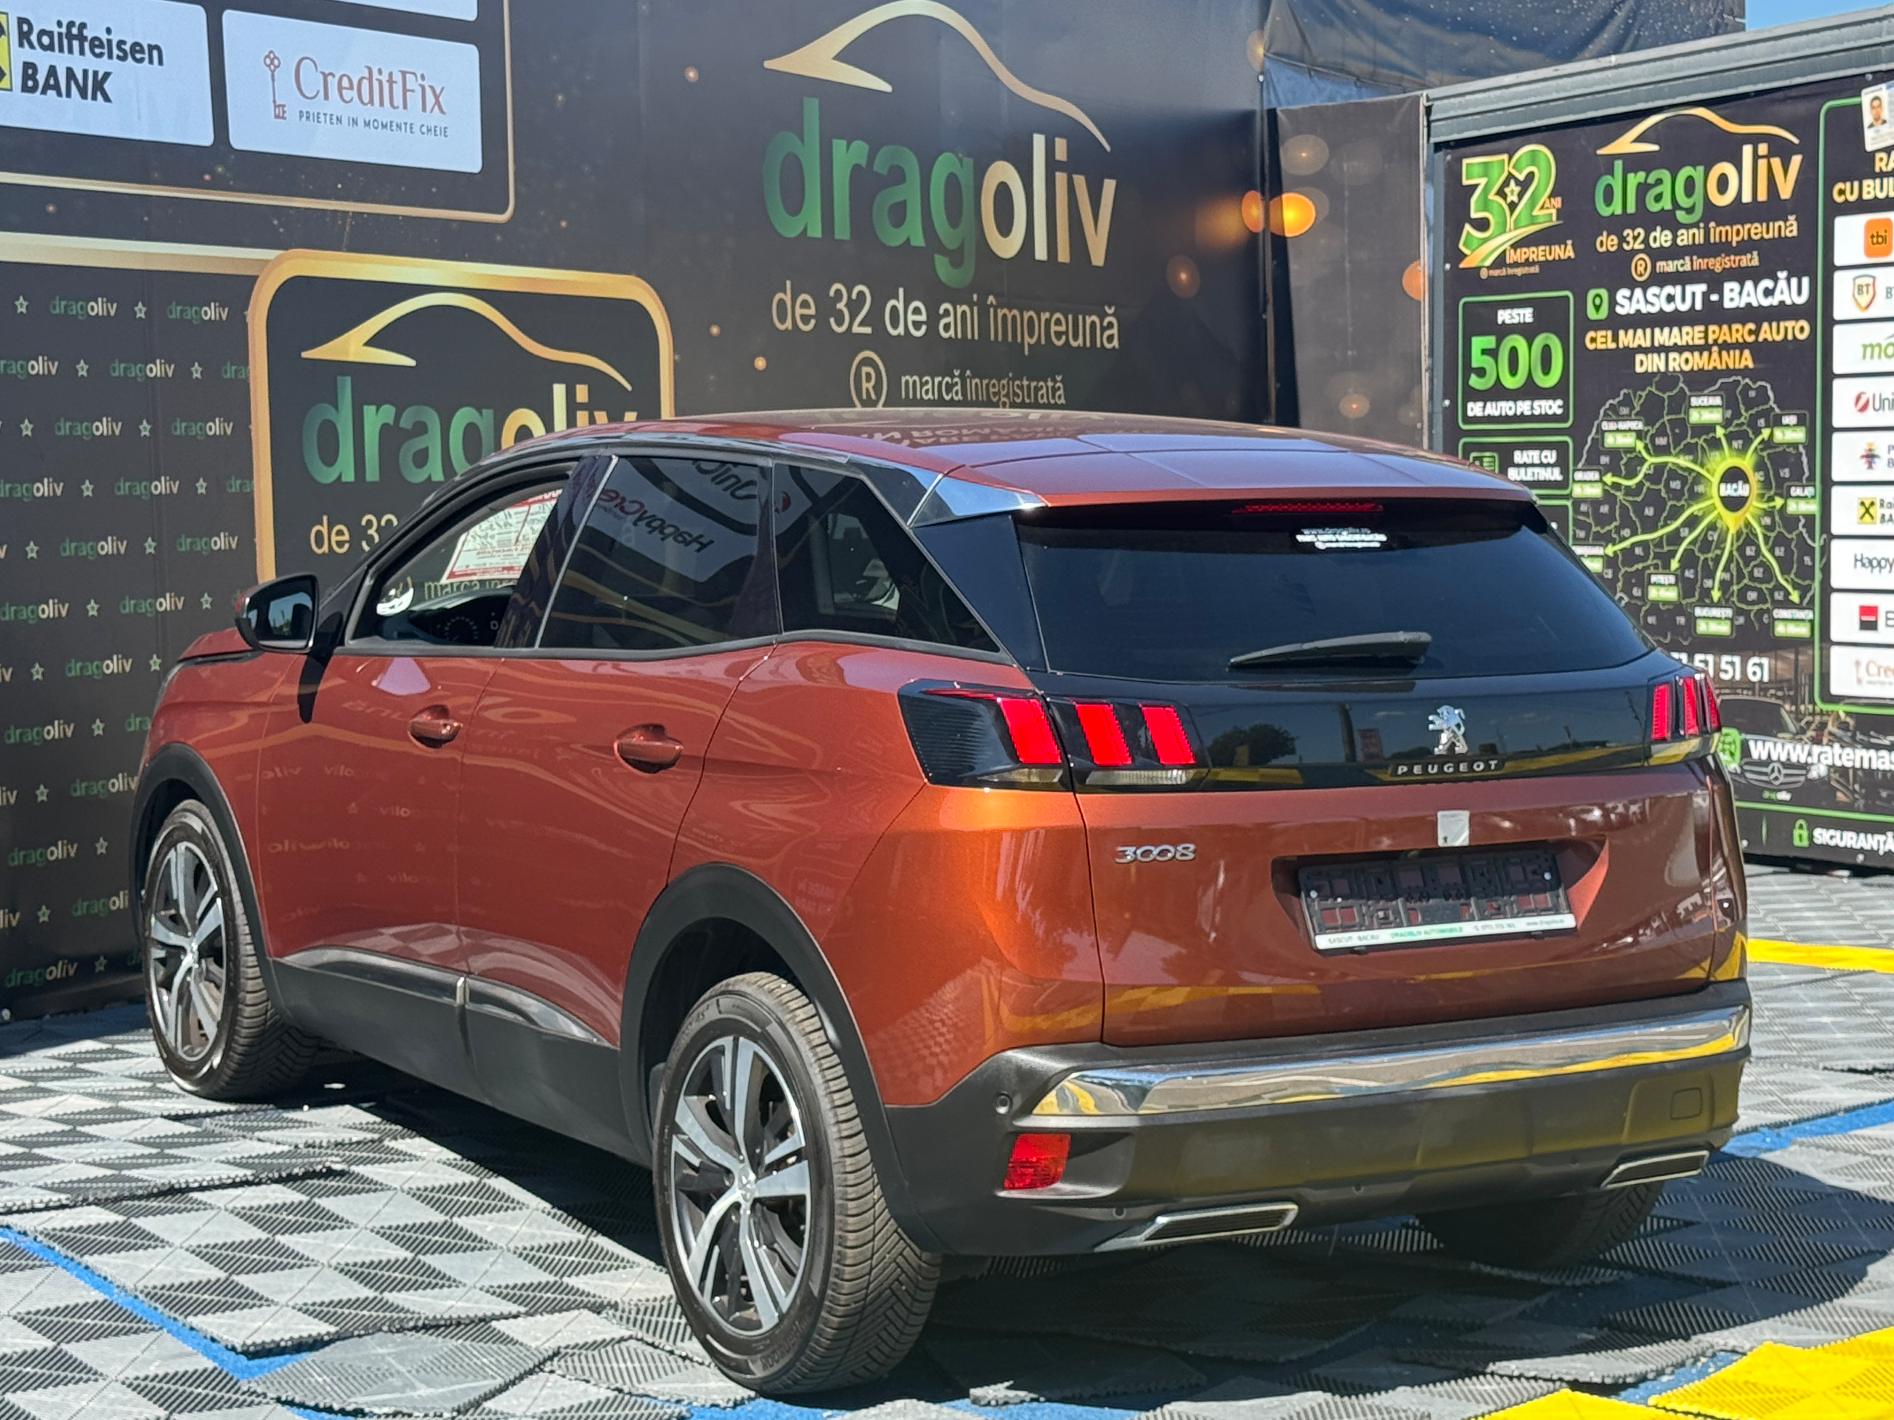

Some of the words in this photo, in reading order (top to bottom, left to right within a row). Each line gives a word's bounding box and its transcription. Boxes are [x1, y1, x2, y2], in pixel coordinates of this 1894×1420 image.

[16, 15, 164, 66] Raiffeisen
[21, 60, 113, 104] BANK
[294, 55, 447, 115] CreditFix
[299, 110, 343, 125] PRIETEN
[348, 116, 359, 127] IN
[363, 117, 415, 134] MOMENTE
[419, 123, 449, 138] CHEIE
[764, 97, 1116, 288] dragoliv
[1594, 142, 1803, 223] dragoliv
[1832, 180, 1859, 204] CU
[1458, 143, 1557, 255] 32
[1543, 196, 1562, 209] ANI
[1595, 231, 1618, 252] de
[1622, 228, 1645, 250] 32
[1649, 225, 1673, 248] de
[1676, 222, 1704, 246] ani
[1708, 215, 1798, 247] împreună
[1869, 230, 1888, 246] tbi
[1506, 239, 1575, 264] ÎMPREUNĂ
[1656, 256, 1691, 273] marcă
[1692, 251, 1759, 273] înregistrată
[1615, 283, 1707, 316] SASCUT
[1723, 270, 1810, 309] BACĂU
[50, 295, 117, 320] dragoliv
[166, 301, 229, 324] dragoliv
[771, 281, 816, 333] de
[828, 282, 873, 335] 32
[884, 287, 927, 338] de
[938, 294, 979, 341] ani
[987, 295, 1120, 355] împreună
[1497, 307, 1534, 325] PESTE
[1585, 330, 1617, 350] CEL
[1618, 328, 1650, 348] MAI
[1653, 325, 1706, 347] MARE
[1708, 321, 1756, 343] PARC
[1758, 319, 1810, 342] AUTO
[0, 355, 58, 379] ragoliv
[109, 358, 175, 381] dragoliv
[1468, 332, 1563, 390] 500
[1635, 353, 1667, 373] DIN
[1668, 346, 1754, 372] ROMÂNIA
[900, 368, 963, 402] marcă
[965, 370, 1066, 409] înregistrată
[1467, 402, 1484, 417] DE
[1484, 401, 1515, 416] AUTO
[1516, 400, 1532, 415] PE
[1532, 399, 1564, 415] STOC
[54, 417, 122, 443] dragoliv
[171, 417, 233, 440] dragoliv
[1513, 450, 1541, 465] RATE
[1541, 450, 1557, 464] CU
[114, 476, 179, 499] dragoliv
[1507, 467, 1563, 481] BULETINUL
[59, 535, 127, 561] dragoliv
[176, 532, 238, 556] dragoliv
[310, 515, 350, 555] de
[119, 593, 185, 617] dragoliv
[65, 654, 132, 679] dragoliv
[1719, 655, 1741, 681] 51
[1746, 656, 1769, 683] 61
[4, 720, 75, 745] dragoliv
[1397, 760, 1498, 775] PEUGEOT
[7, 840, 78, 867] dragoliv
[1115, 843, 1196, 864] 3008
[4, 959, 78, 988] dragoliv
